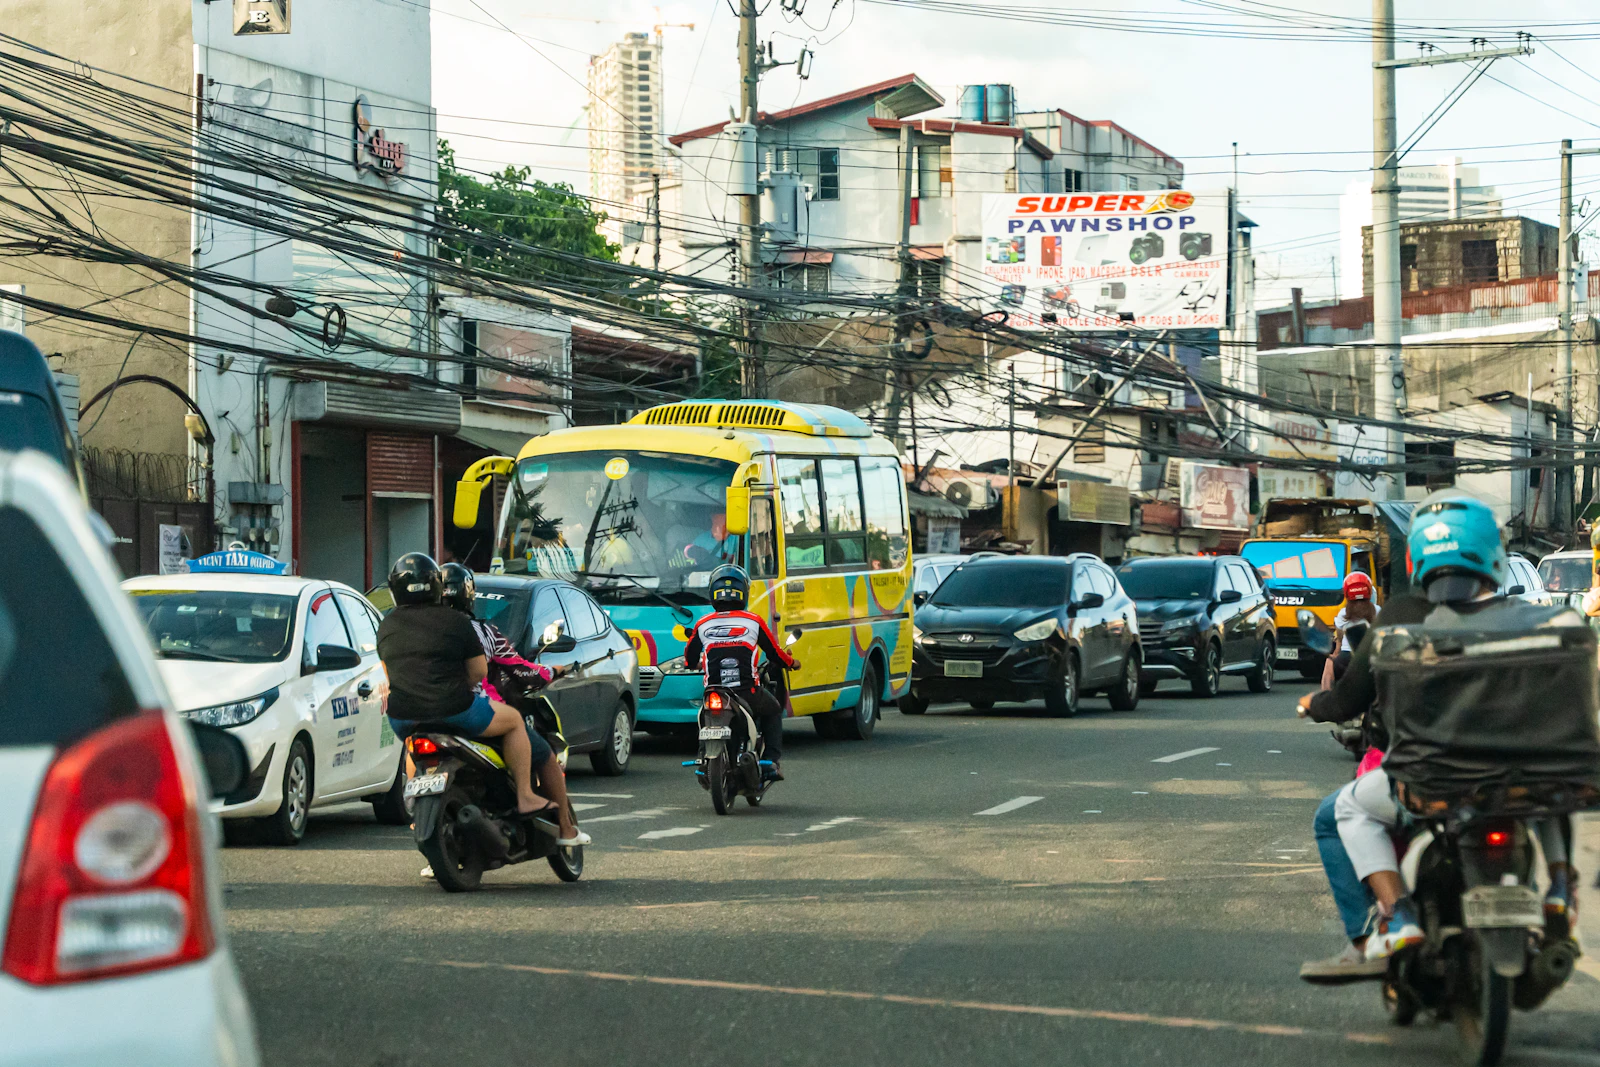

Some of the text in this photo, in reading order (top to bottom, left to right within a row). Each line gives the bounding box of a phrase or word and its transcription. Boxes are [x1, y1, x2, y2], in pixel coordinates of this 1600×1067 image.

[1400, 171, 1448, 180] MARCO POLO
[1015, 194, 1146, 213] SUPER
[1008, 215, 1196, 233] PAWNSHOP
[985, 266, 1025, 274] CELLPHONES
[1036, 265, 1126, 280] IPHONE, IPAD, MACBOOK
[1131, 265, 1162, 277] DSLR
[1174, 270, 1210, 278] CAMERA
[995, 274, 1022, 282] TABLETS
[1040, 316, 1089, 327] ORCYLE
[1150, 315, 1173, 326] PODS
[198, 552, 275, 569] VACANT TAXI OCCUPIED
[1275, 597, 1304, 605] SUZU
[713, 639, 743, 647] RACING
